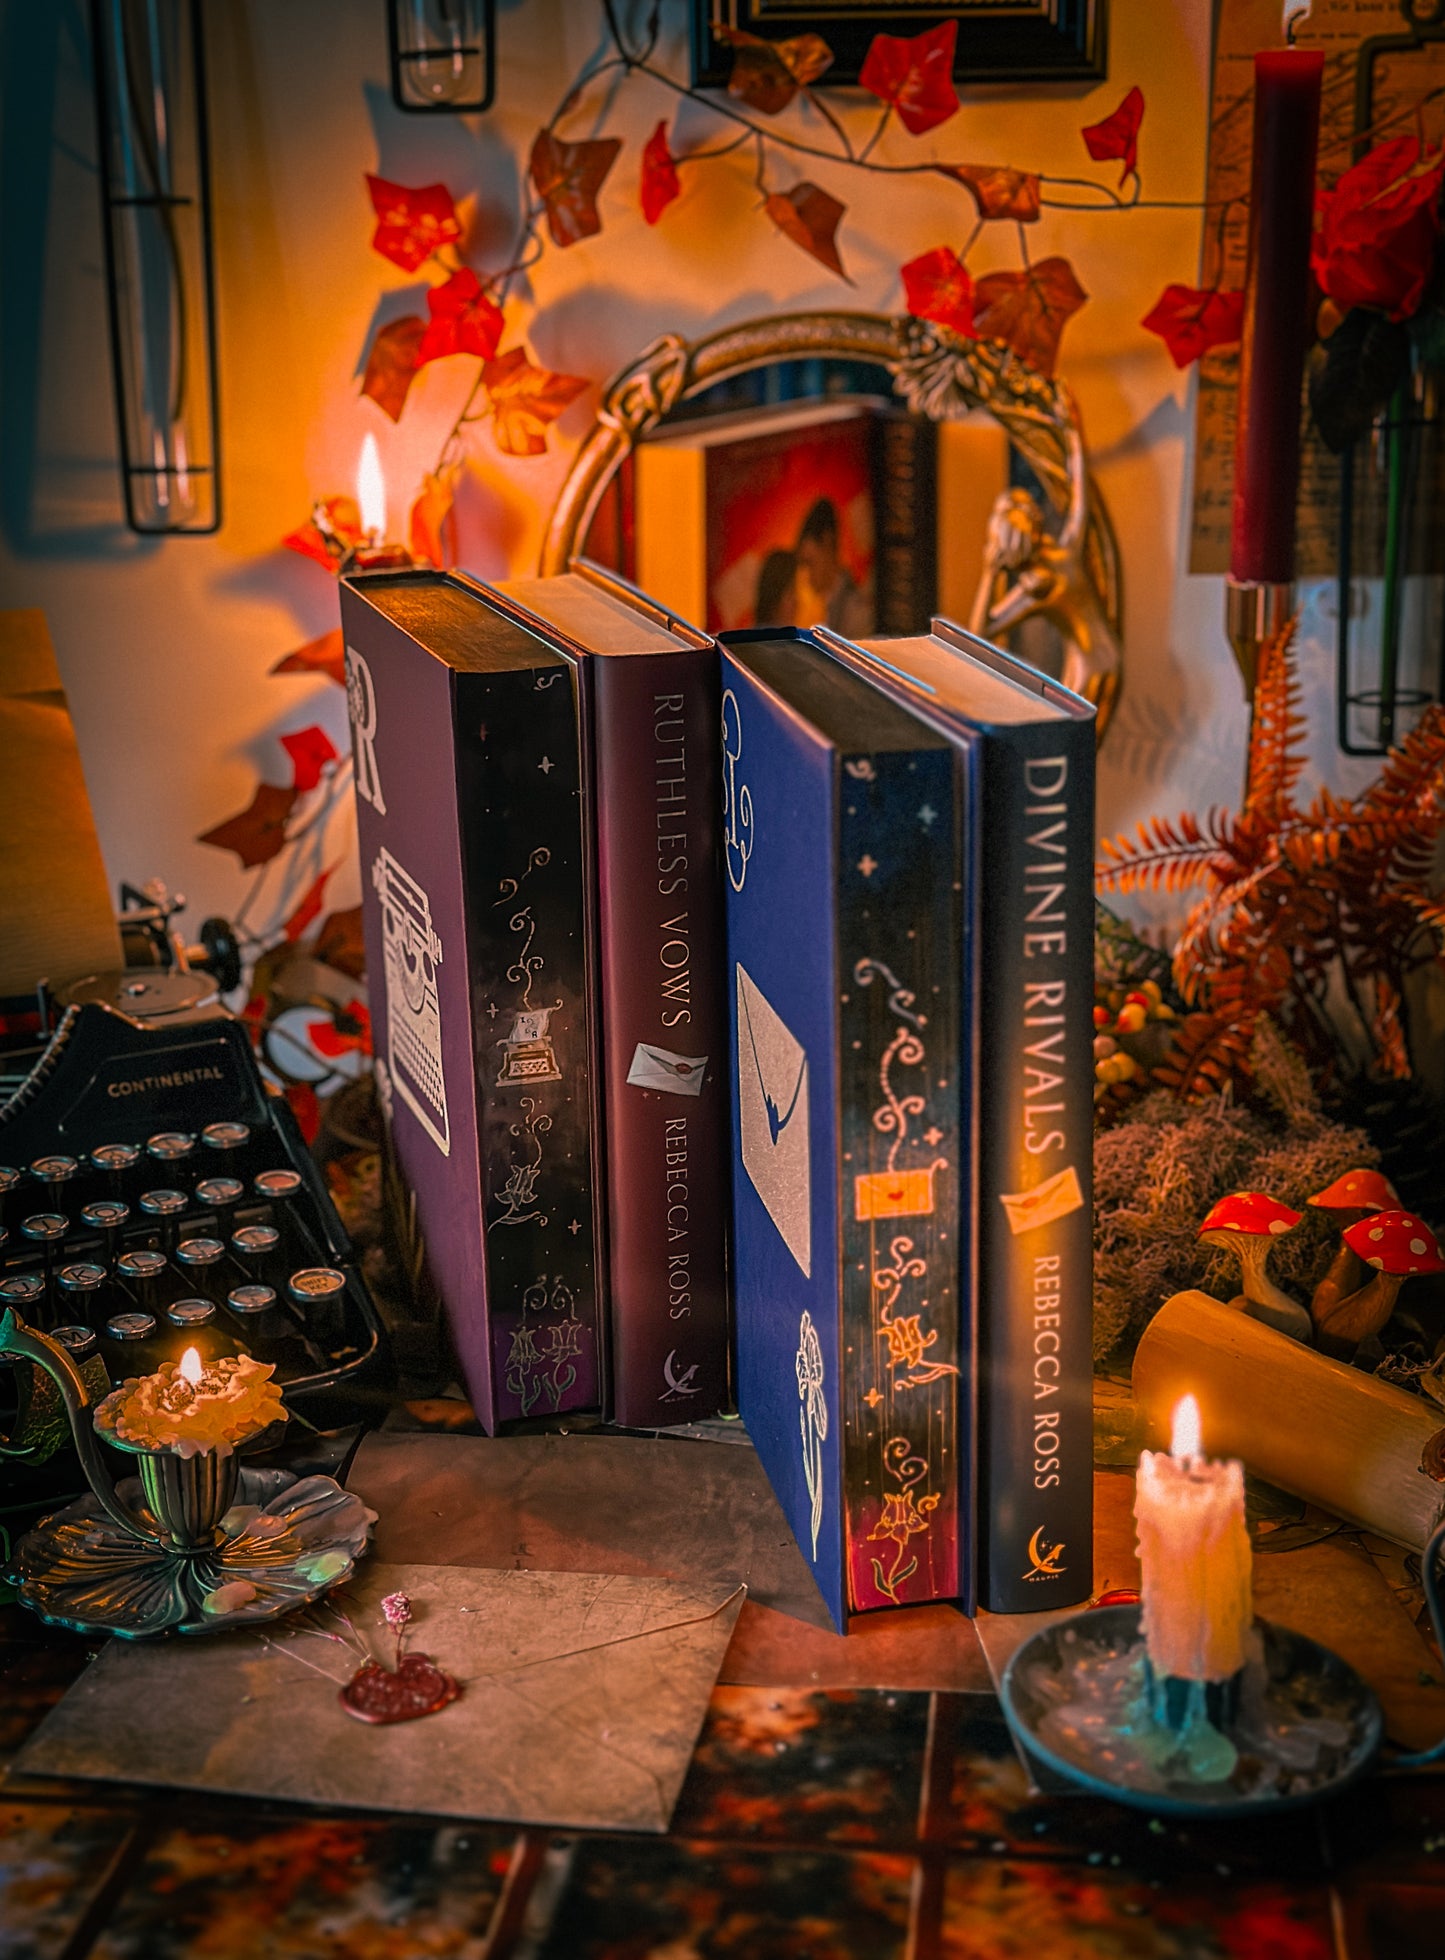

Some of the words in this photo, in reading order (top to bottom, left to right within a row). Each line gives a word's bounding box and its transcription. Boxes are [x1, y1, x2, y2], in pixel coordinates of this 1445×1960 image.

[654, 693, 688, 895] RUTHLESS
[1024, 756, 1068, 959] DIVINE
[659, 911, 692, 1027] VOWS
[107, 1066, 224, 1098] CONTINENTAL
[1023, 980, 1066, 1155] RIVALS
[665, 1117, 689, 1242] REBECCA
[667, 1252, 691, 1320] ROSS
[1034, 1255, 1061, 1400] REBECCA
[1034, 1411, 1060, 1489] ROSS
